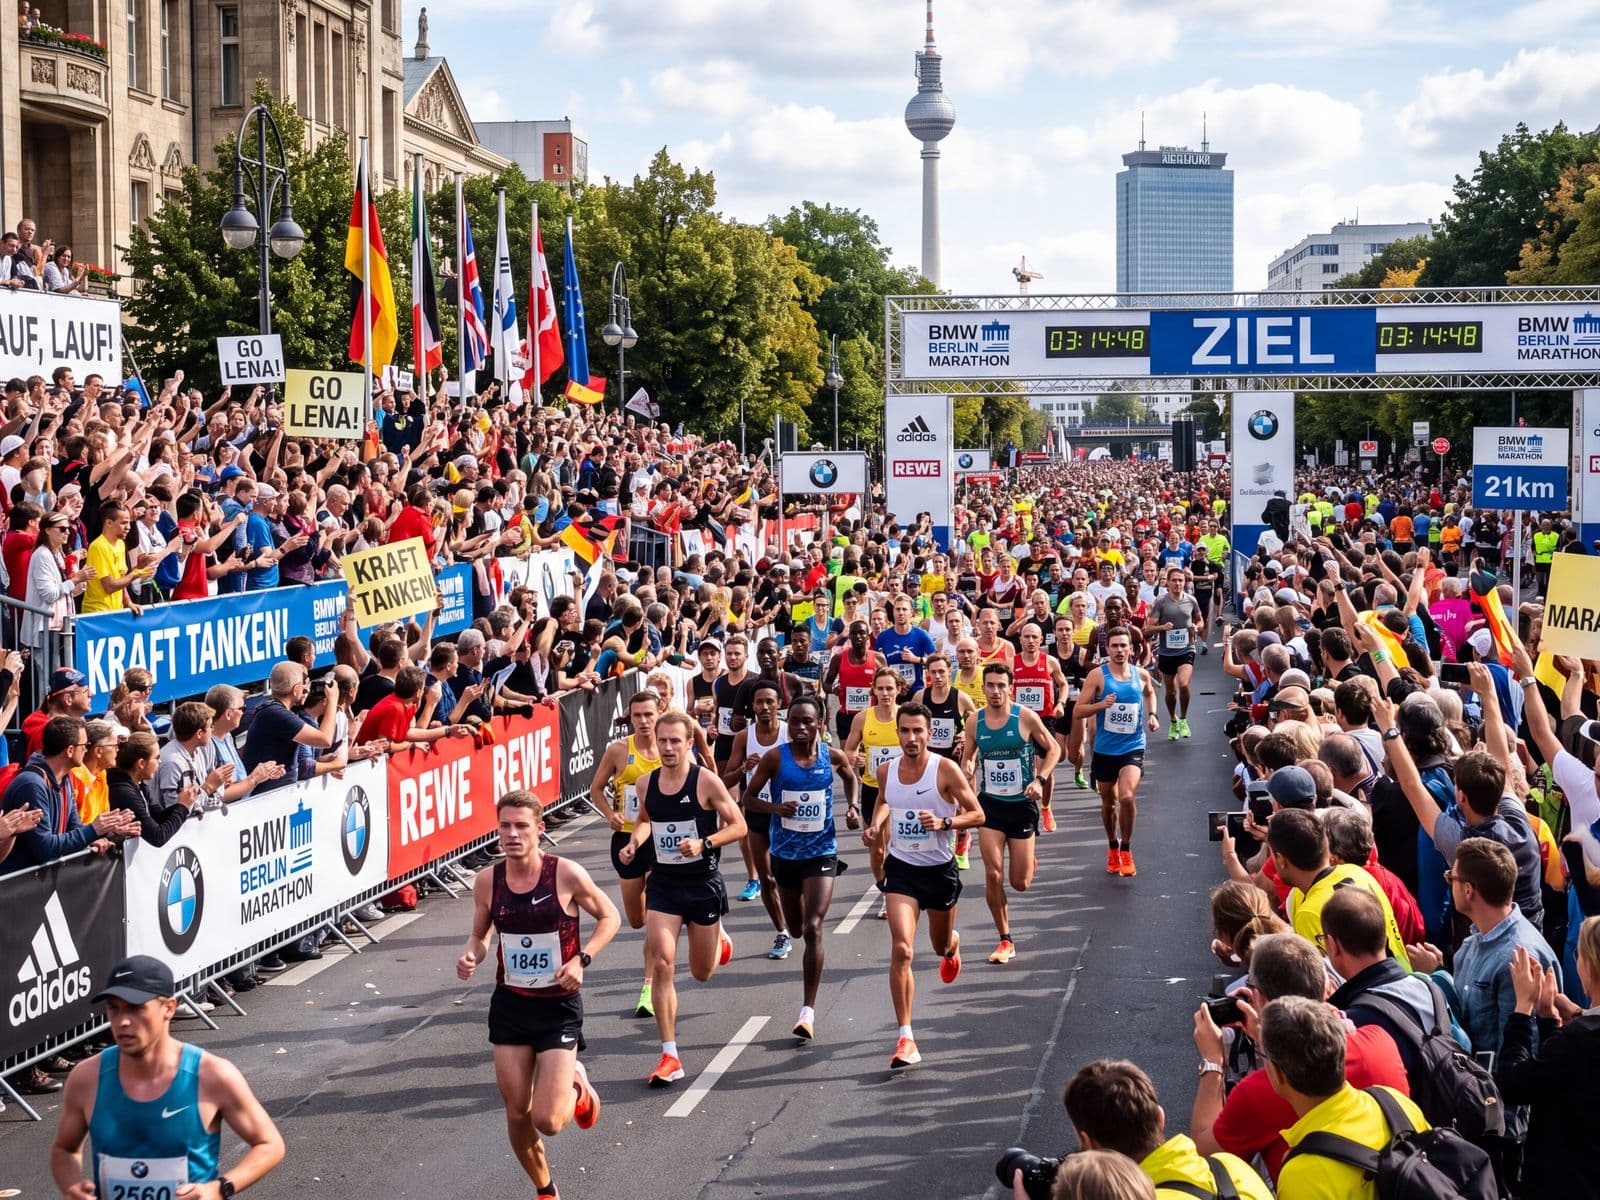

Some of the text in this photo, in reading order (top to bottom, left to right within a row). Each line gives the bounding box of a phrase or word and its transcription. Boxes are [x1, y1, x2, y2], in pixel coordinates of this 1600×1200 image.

[928, 325, 978, 340] BMW
[1379, 325, 1478, 346] 03:14:48
[1518, 316, 1570, 333] BMW
[51, 318, 113, 362] LAUF!
[237, 339, 263, 357] GO
[928, 342, 979, 353] BERLIN
[1050, 330, 1145, 350] 03:14:48
[1192, 316, 1335, 365] ZIEL
[1518, 335, 1570, 346] BERLIN
[224, 359, 281, 379] LENA!
[928, 354, 1010, 367] MARATHON
[309, 376, 342, 400] GO
[290, 404, 359, 430] LENA!
[896, 430, 937, 442] adidas
[1498, 436, 1526, 446] BMW
[894, 461, 939, 476] REWE
[1484, 475, 1555, 499] 21km
[353, 546, 419, 585] KRAFT
[357, 574, 436, 616] TANKEN!
[313, 597, 336, 621] BMW
[86, 607, 289, 695] KRAFT TANKEN!
[492, 725, 553, 806] REWE
[399, 755, 473, 847] REWE
[797, 804, 820, 817] 660
[898, 822, 927, 835] 3544
[240, 815, 287, 865] BMW
[162, 847, 201, 888] BMW
[240, 855, 287, 895] BERLIN
[240, 873, 313, 926] MARATHON
[511, 952, 549, 970] 1845
[8, 965, 92, 1027] adidas
[112, 1184, 171, 1200] 2560
